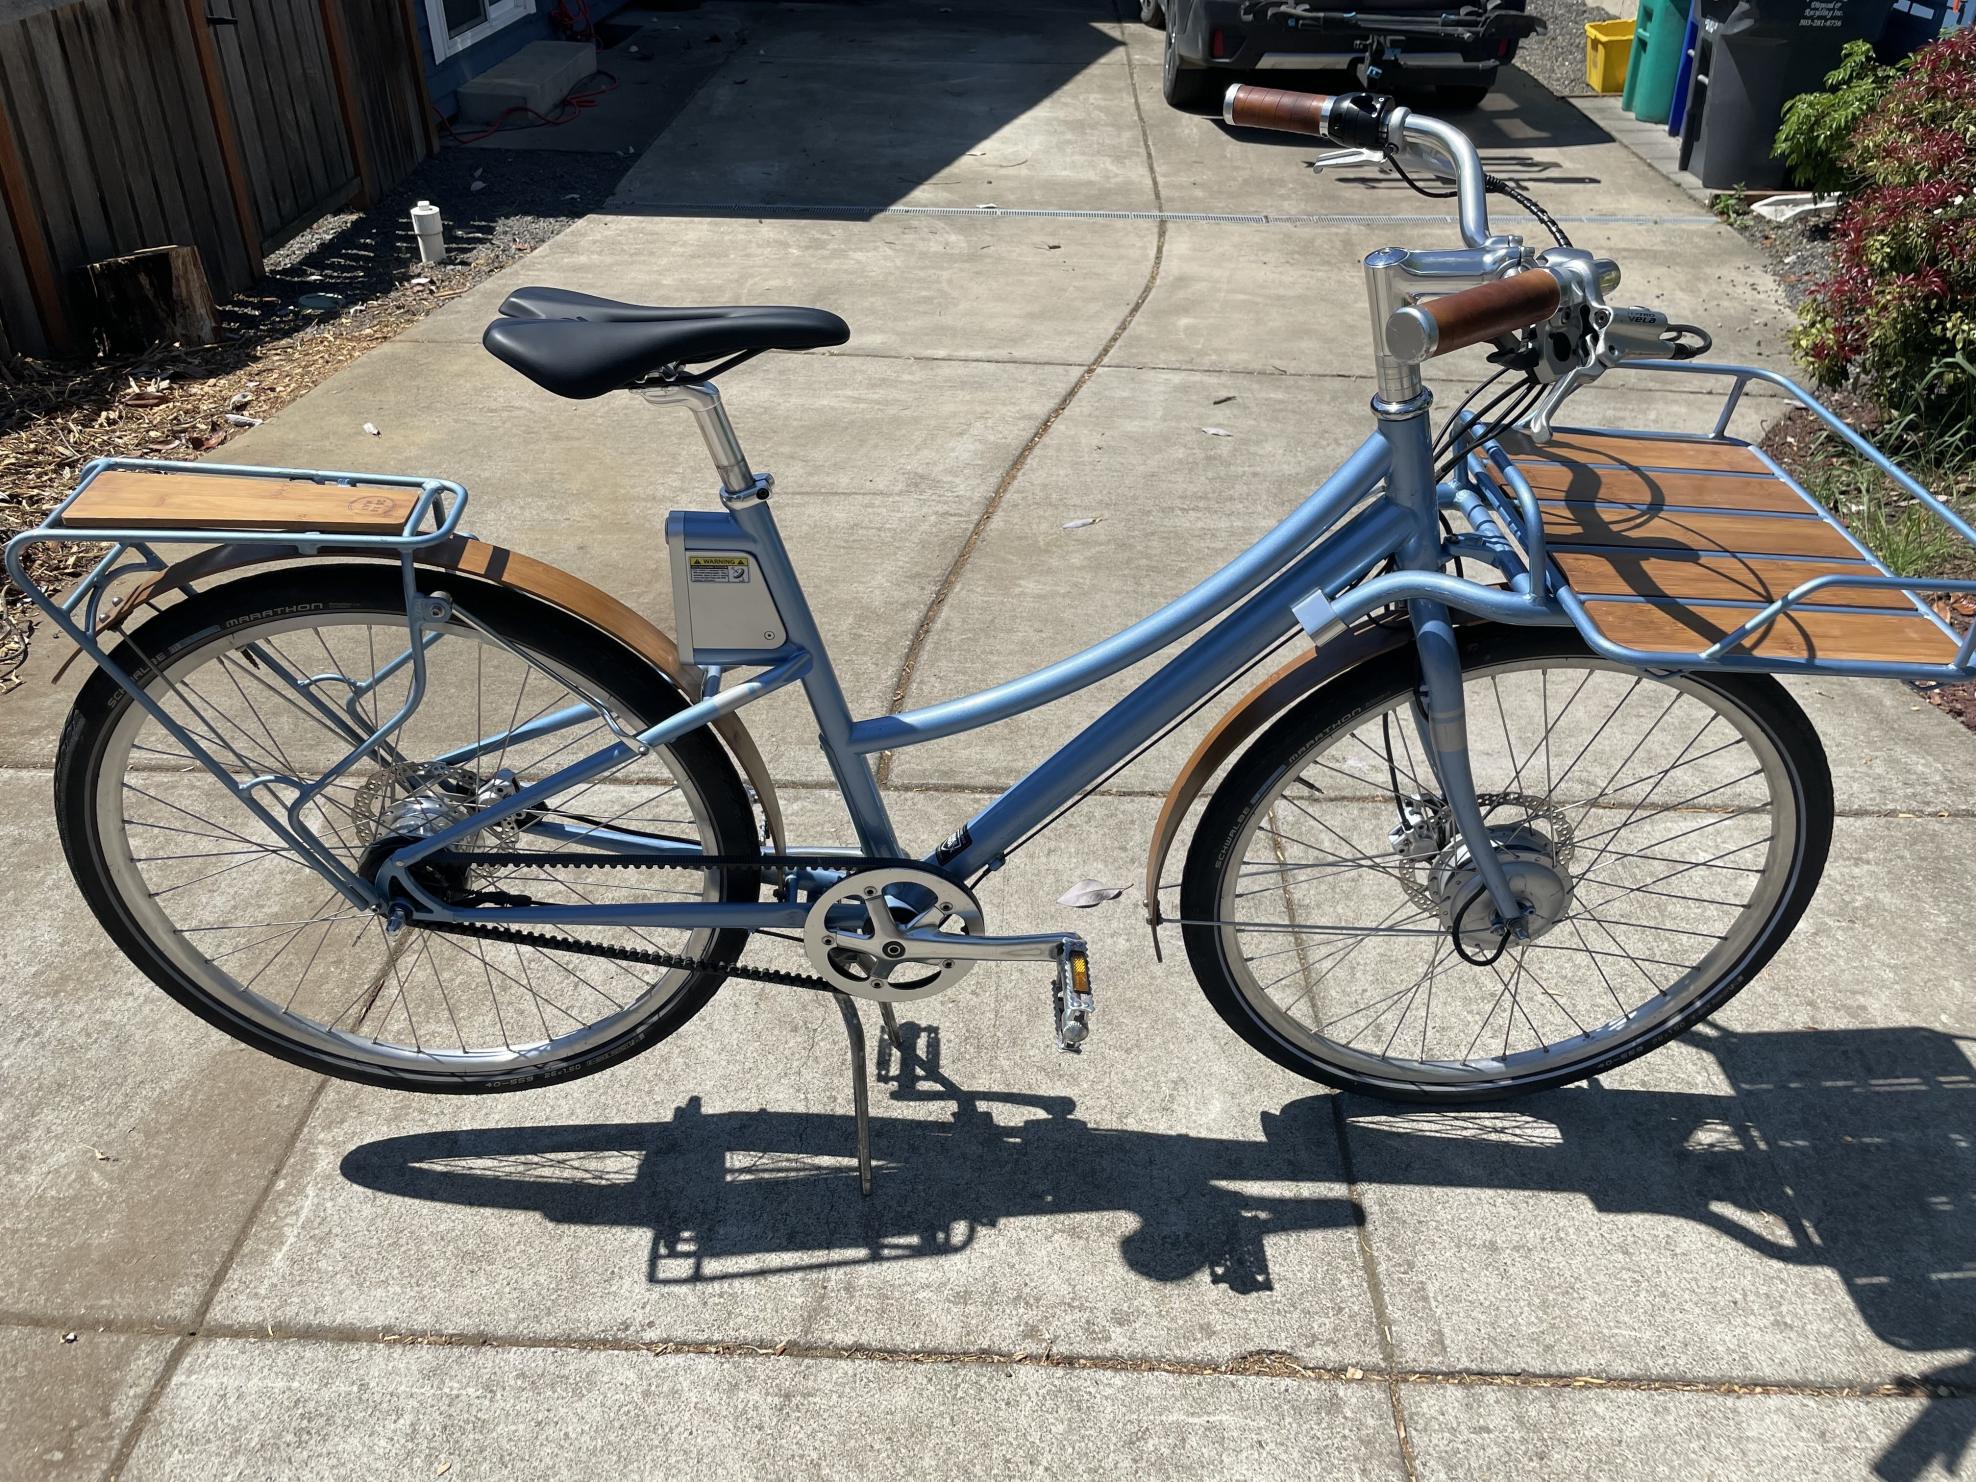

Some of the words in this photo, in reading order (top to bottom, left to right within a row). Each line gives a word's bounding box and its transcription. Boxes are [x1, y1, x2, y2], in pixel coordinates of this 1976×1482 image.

[1804, 8, 1833, 18] Recycling
[225, 602, 323, 628] MARATHON
[108, 652, 167, 708] SCHALE
[1288, 706, 1362, 763] MARATHON
[1214, 806, 1250, 870] SCHWALBE
